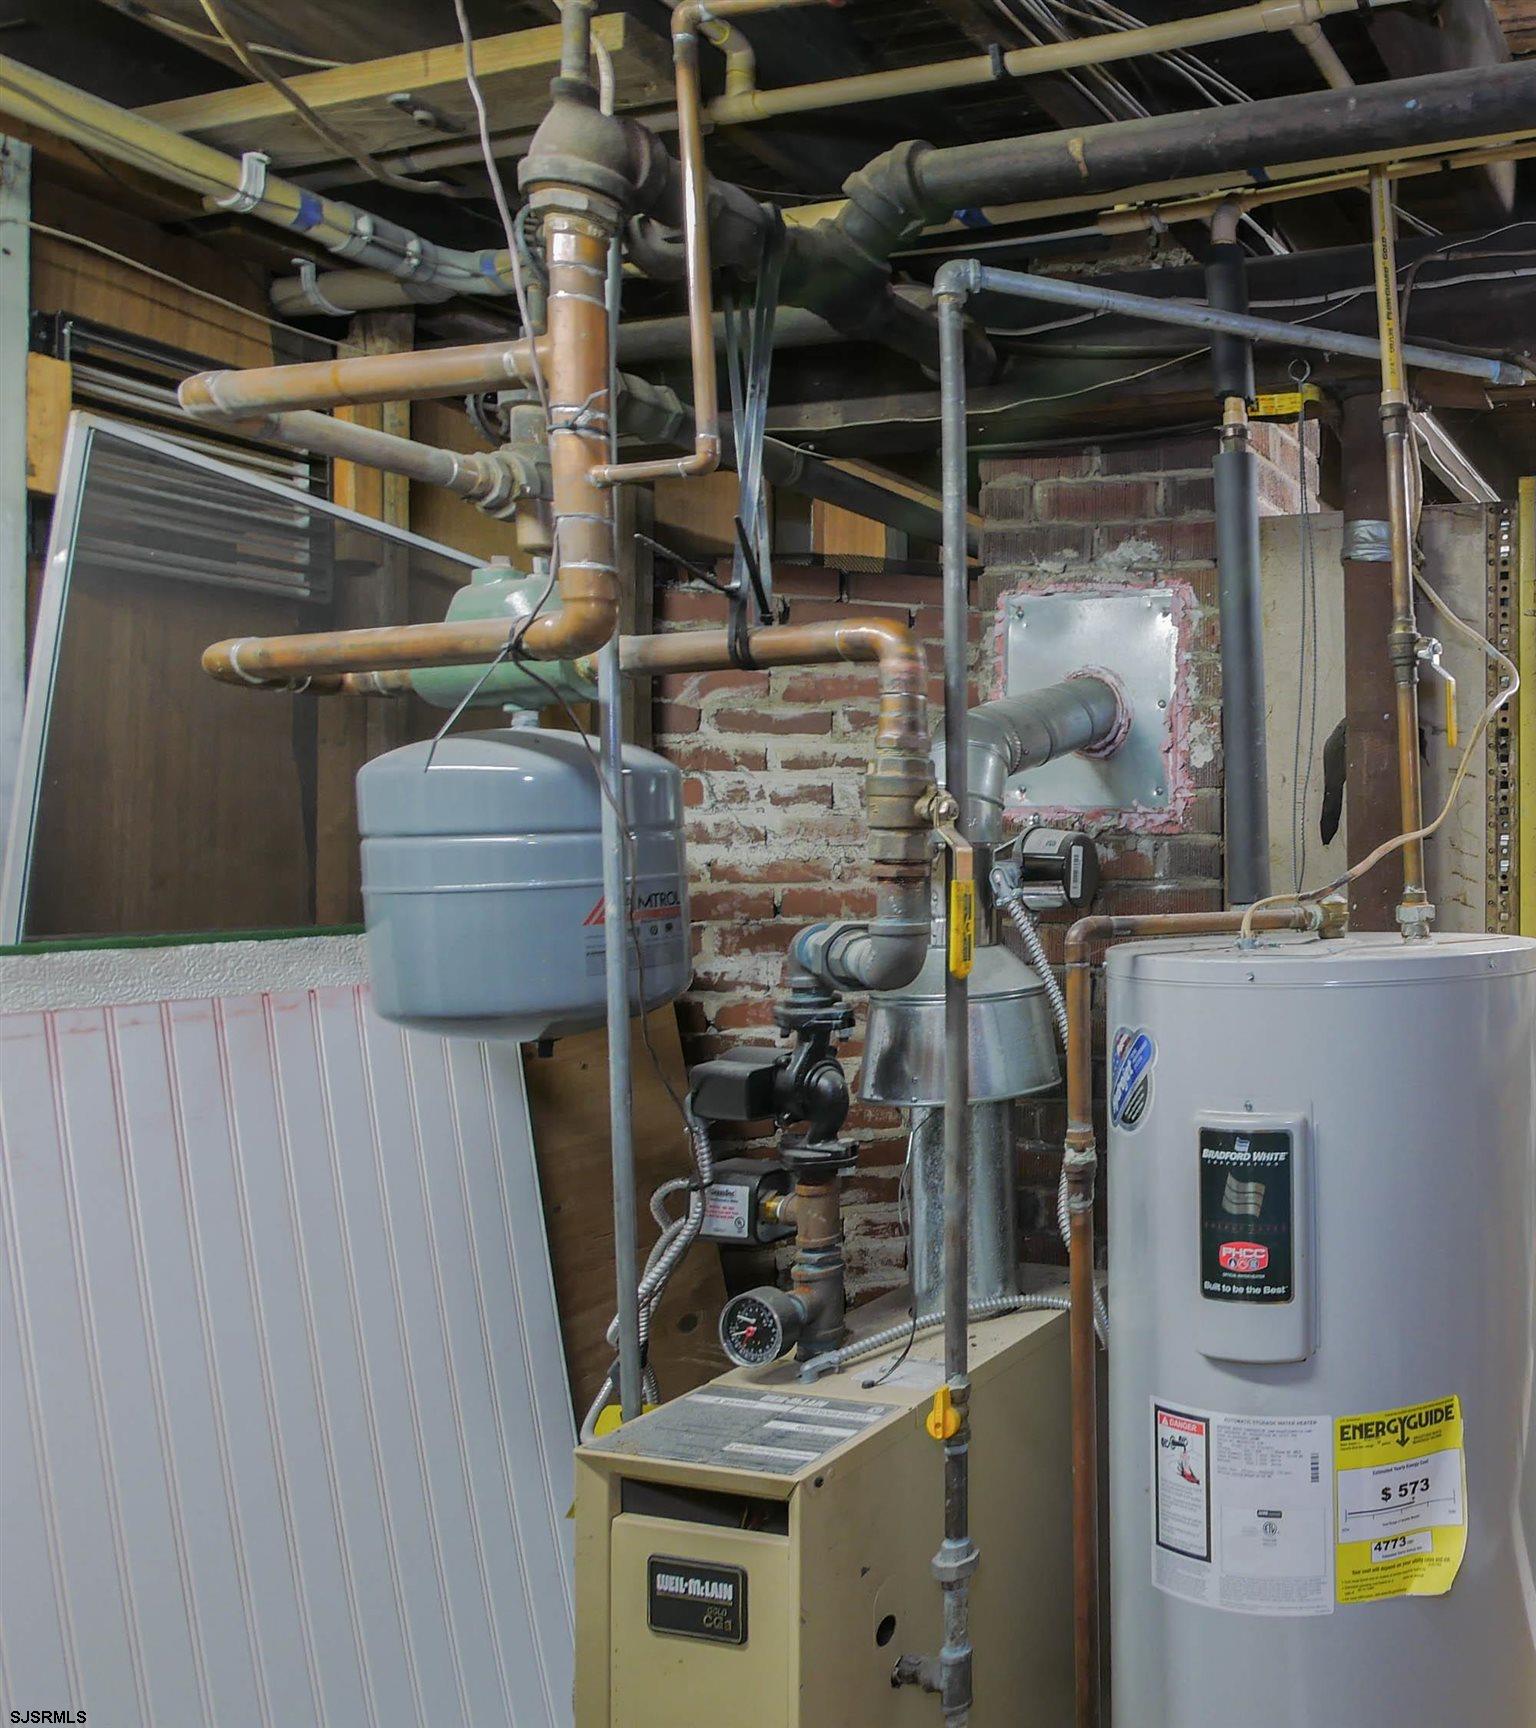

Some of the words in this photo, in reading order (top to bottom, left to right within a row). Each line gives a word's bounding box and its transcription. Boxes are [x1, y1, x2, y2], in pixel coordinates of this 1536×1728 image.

[1202, 1148, 1251, 1161] BRADFORD
[1252, 1151, 1287, 1162] WHITE
[1222, 1247, 1267, 1259] PHCC
[1221, 1284, 1231, 1292] to
[1232, 1284, 1244, 1293] be
[1246, 1285, 1262, 1294] the
[1263, 1286, 1286, 1295] Best
[1168, 1418, 1198, 1432] DANGER
[1340, 1402, 1455, 1441] ENERGYGUIDE
[1381, 1486, 1392, 1503] $
[1398, 1478, 1430, 1498] 573
[1373, 1536, 1407, 1552] 4773
